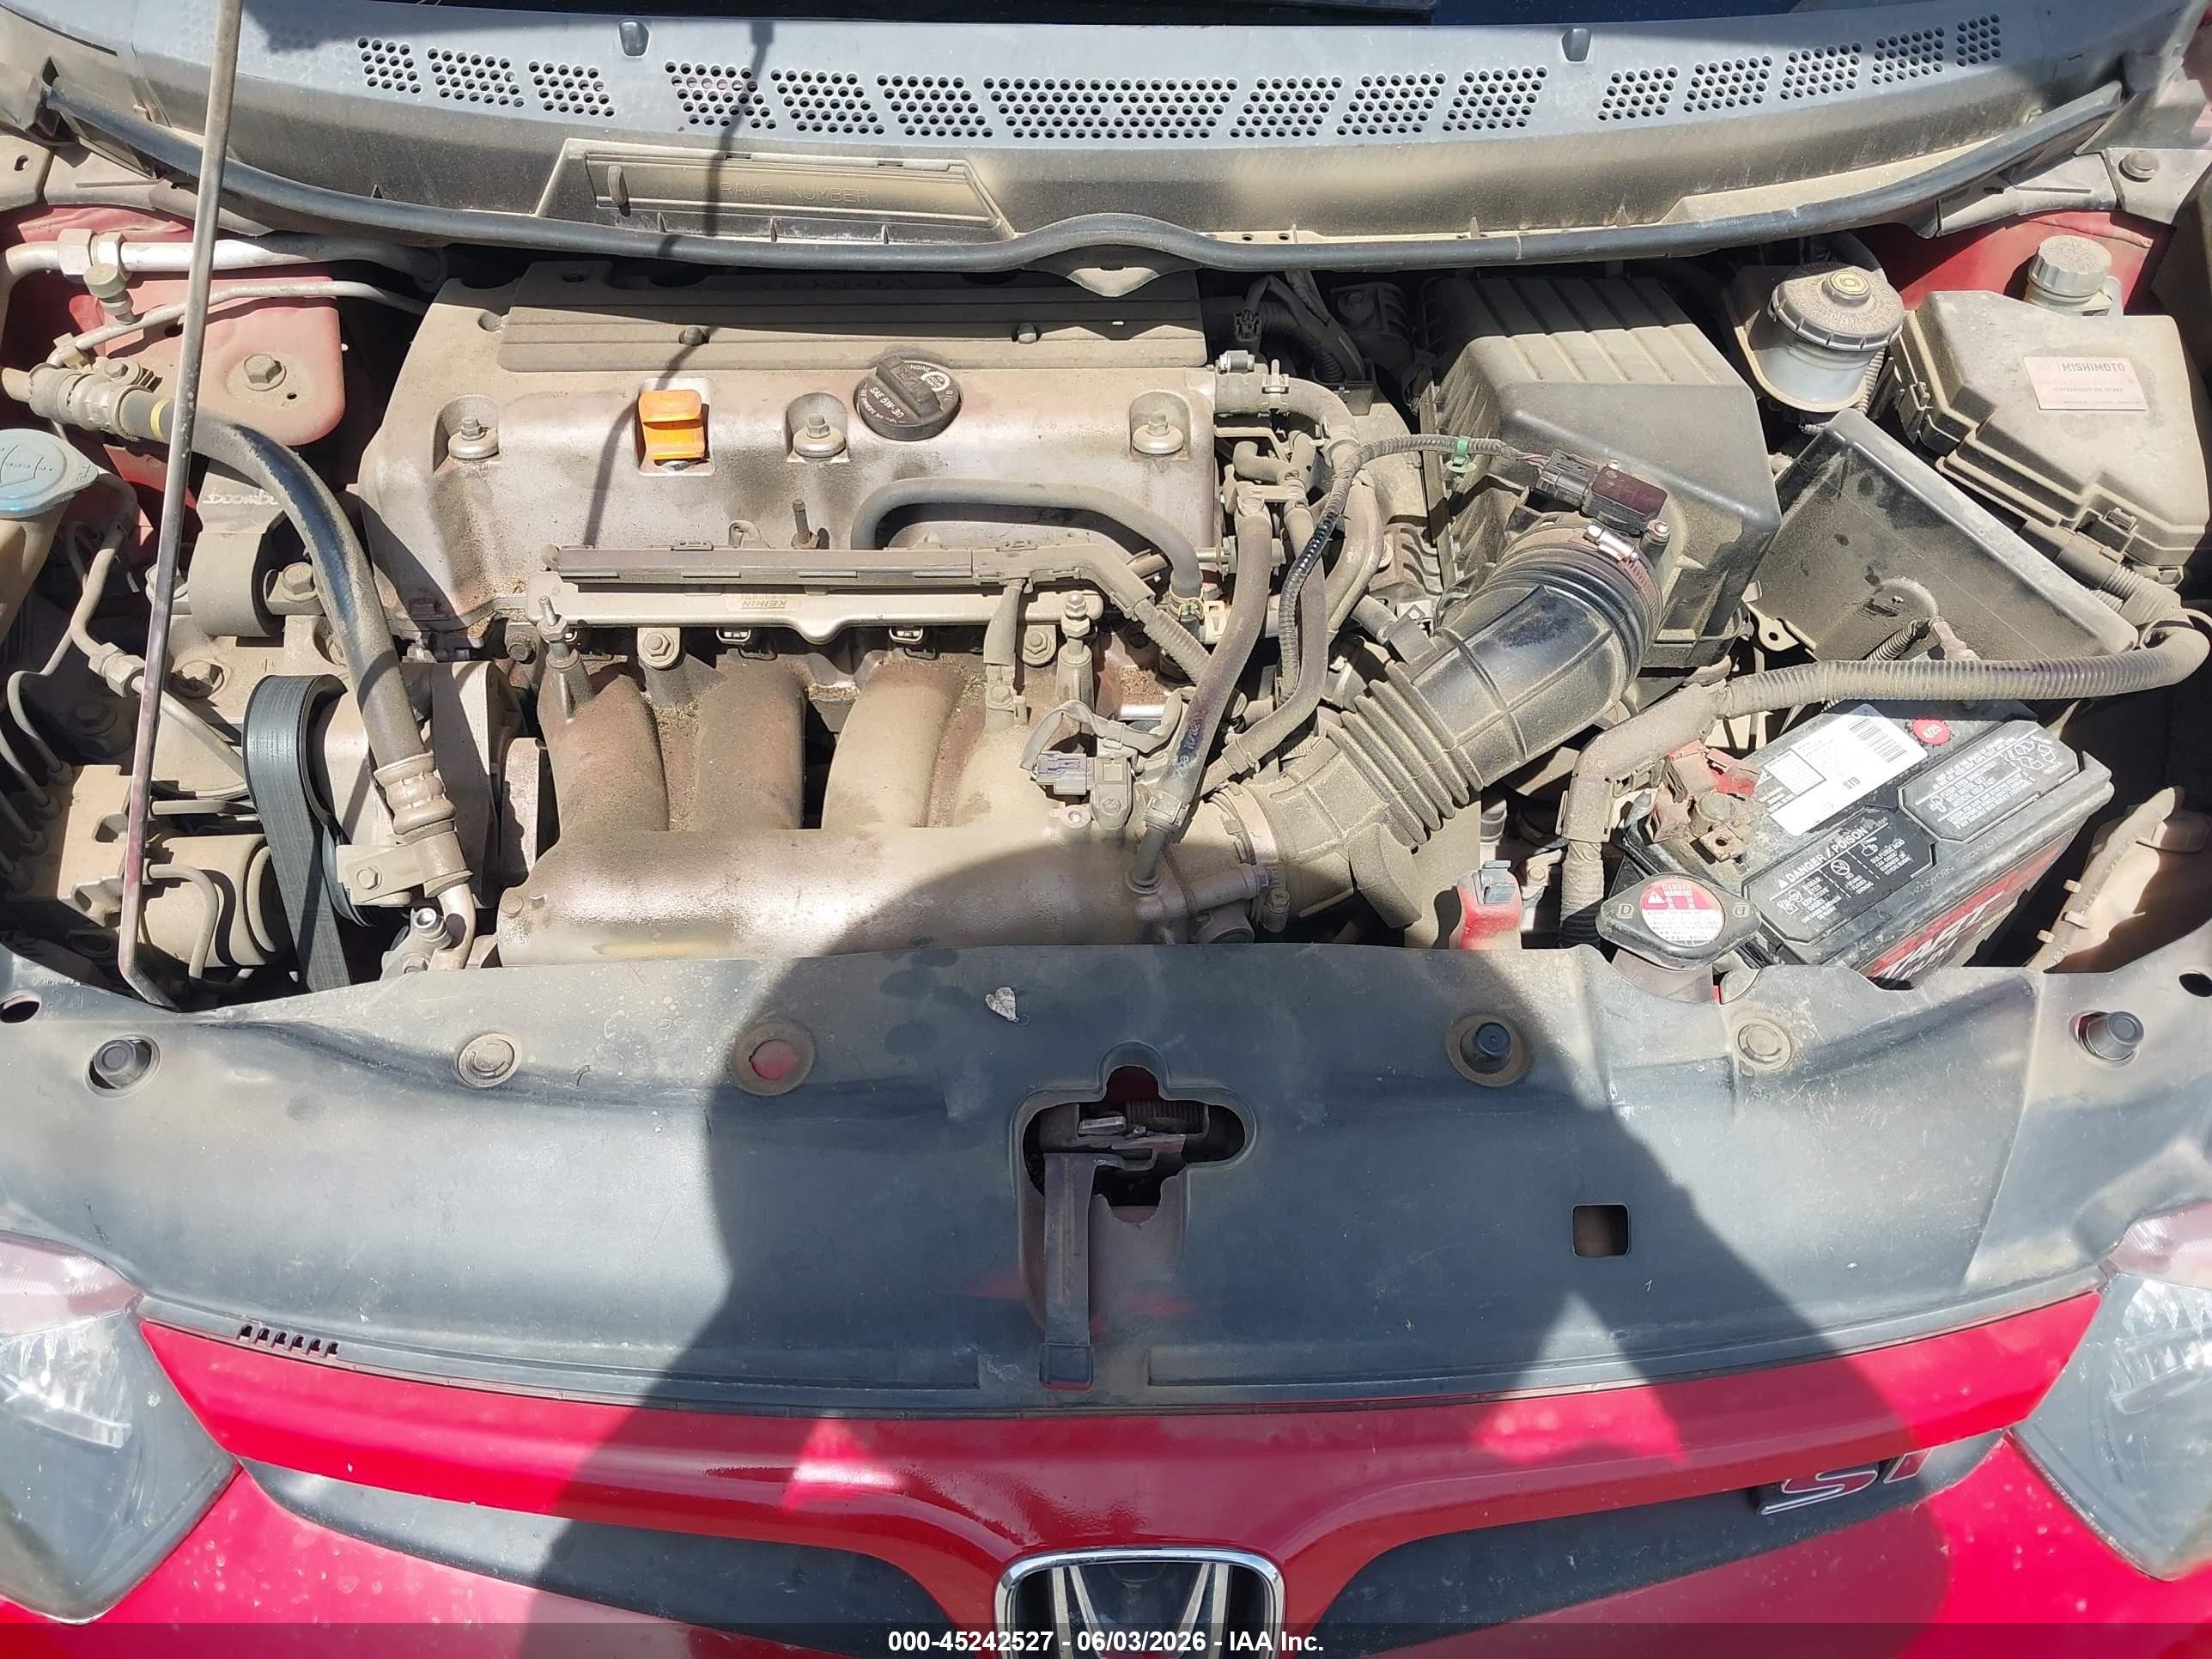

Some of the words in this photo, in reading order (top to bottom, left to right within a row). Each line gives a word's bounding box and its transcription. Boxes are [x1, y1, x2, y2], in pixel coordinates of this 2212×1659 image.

[788, 185, 872, 203] NUMBER
[2061, 362, 2126, 372] MISHIMOTO
[869, 386, 884, 400] SAE
[1843, 776, 1861, 788] STD
[1784, 854, 1827, 881] DANGER
[1829, 827, 1869, 852] POISON
[1801, 888, 1830, 906] EXPLOSIVE
